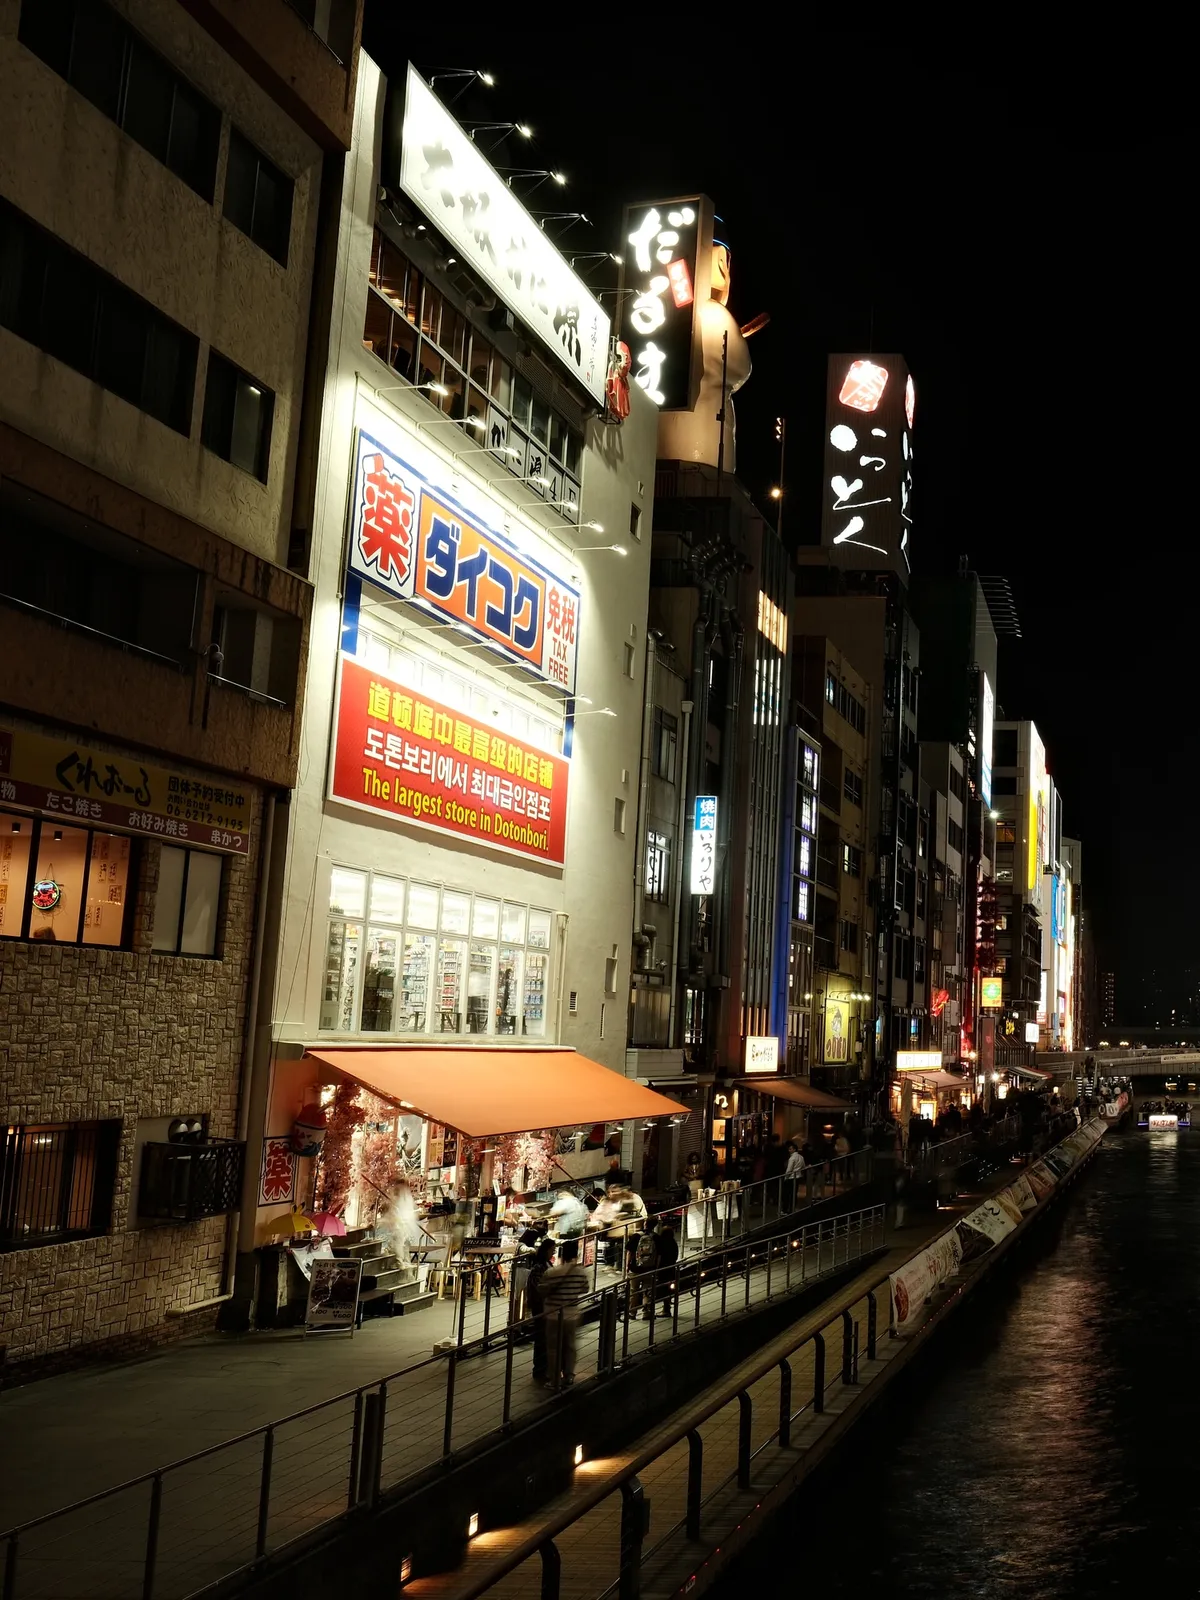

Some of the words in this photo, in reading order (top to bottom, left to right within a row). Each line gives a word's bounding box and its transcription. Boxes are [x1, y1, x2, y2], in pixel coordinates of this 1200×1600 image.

[629, 207, 695, 405] だるま
[361, 453, 416, 588] 薬
[425, 520, 540, 650] ダイコク
[547, 585, 576, 641] 免税
[552, 637, 569, 664] TAX
[548, 659, 570, 688] FREE
[168, 776, 245, 809] 団体予約受付中
[366, 730, 468, 791] 도톤보리에서
[471, 768, 551, 822] 최대급인점포
[46, 792, 102, 818] たこ焼き
[166, 804, 244, 831] 06-6212-9195
[363, 767, 391, 802] The
[394, 777, 442, 818] largest
[445, 797, 477, 830] store
[480, 806, 491, 834] in
[494, 811, 549, 852] Dotonbori.
[700, 799, 715, 829] 焼肉
[129, 811, 189, 838] お好み焼き
[210, 829, 243, 847] 串かつ
[699, 832, 713, 891] いろりや
